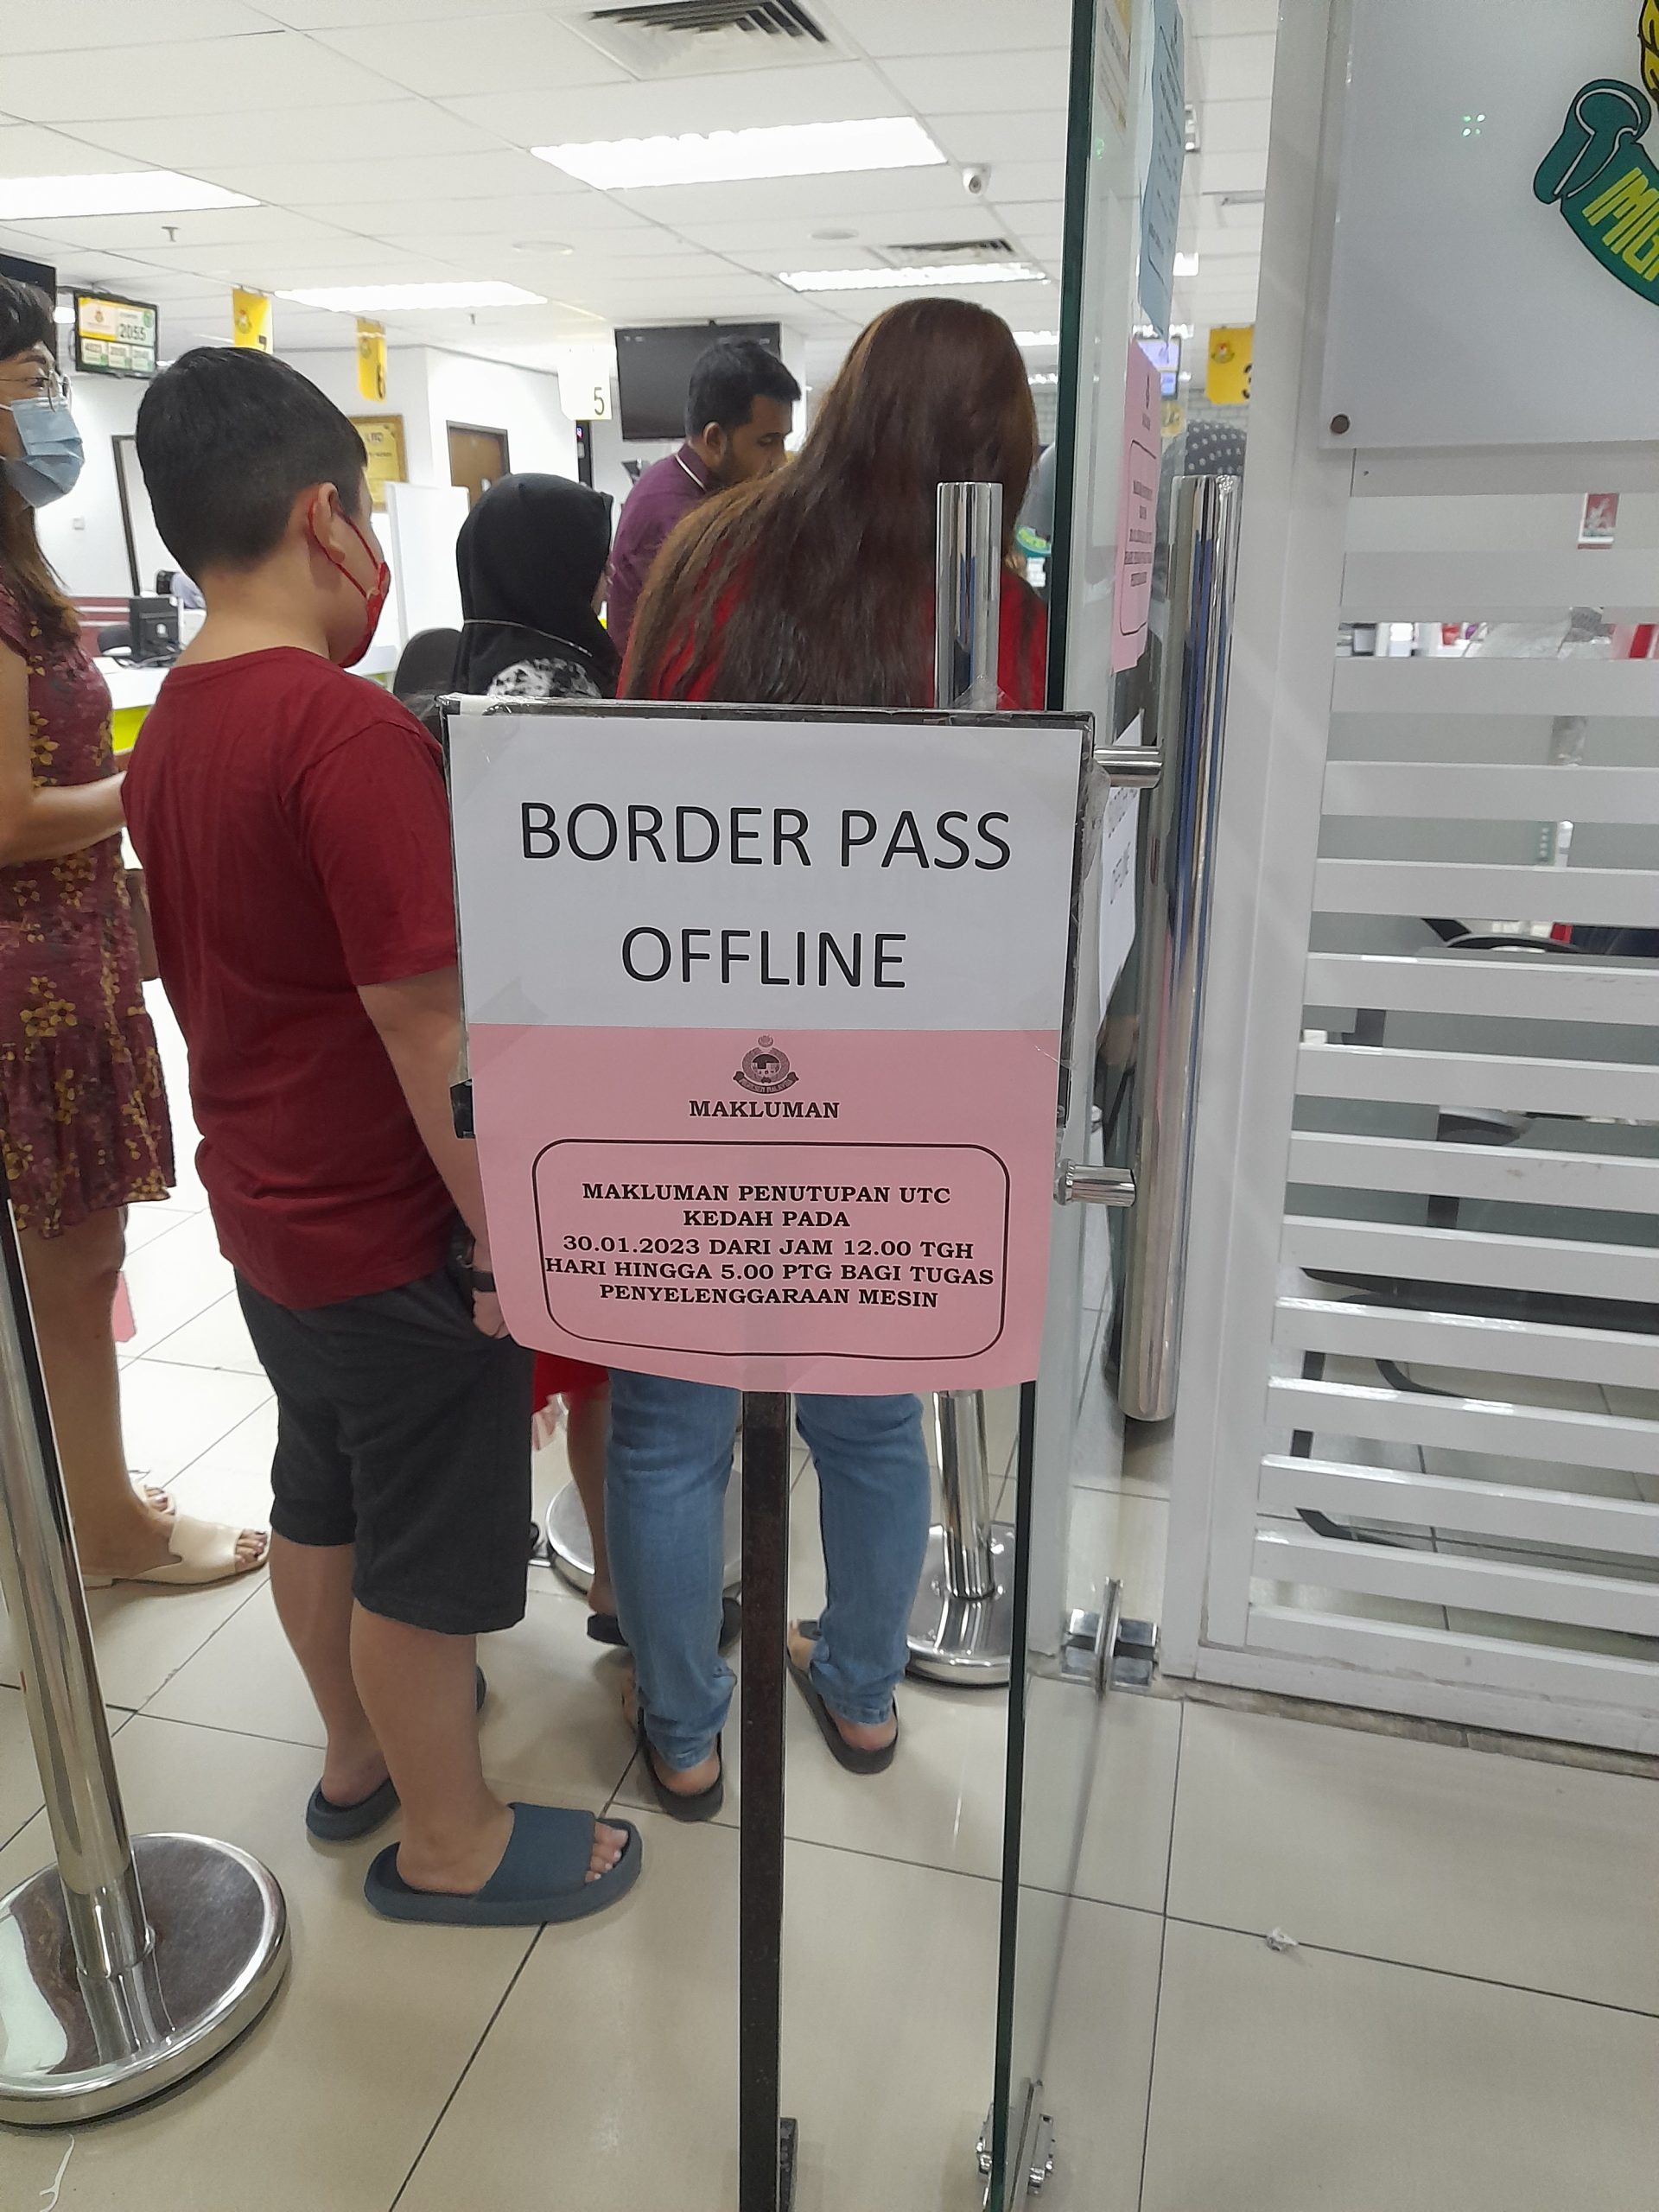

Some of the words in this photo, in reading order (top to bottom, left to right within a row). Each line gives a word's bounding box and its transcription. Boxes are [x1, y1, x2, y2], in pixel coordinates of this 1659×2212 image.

[594, 386, 605, 416] 5
[521, 802, 811, 867] BORDER
[841, 810, 1011, 870] PASS
[622, 926, 906, 988] OFFLINE
[689, 1100, 840, 1119] MAKLUMAN
[582, 1183, 729, 1201] MAKLUMAN
[738, 1185, 891, 1203] PENUTUPAN
[899, 1187, 951, 1204] UTC
[683, 1210, 773, 1227] KEDAH
[781, 1211, 851, 1227] PADA
[563, 1235, 700, 1255] 30.01.2023
[709, 1239, 772, 1255] DARI
[779, 1239, 833, 1255] JAM
[843, 1239, 912, 1256] 12.00
[919, 1241, 974, 1260] TGH
[544, 1257, 607, 1276] HARI
[613, 1261, 713, 1280] HINGGA
[721, 1263, 774, 1281] 5.00
[782, 1263, 833, 1281] PTG
[840, 1264, 901, 1281] BAGI
[909, 1265, 995, 1285] TUGAS
[599, 1284, 850, 1305] PENYELENGGARAAN
[858, 1288, 938, 1308] MESIN
